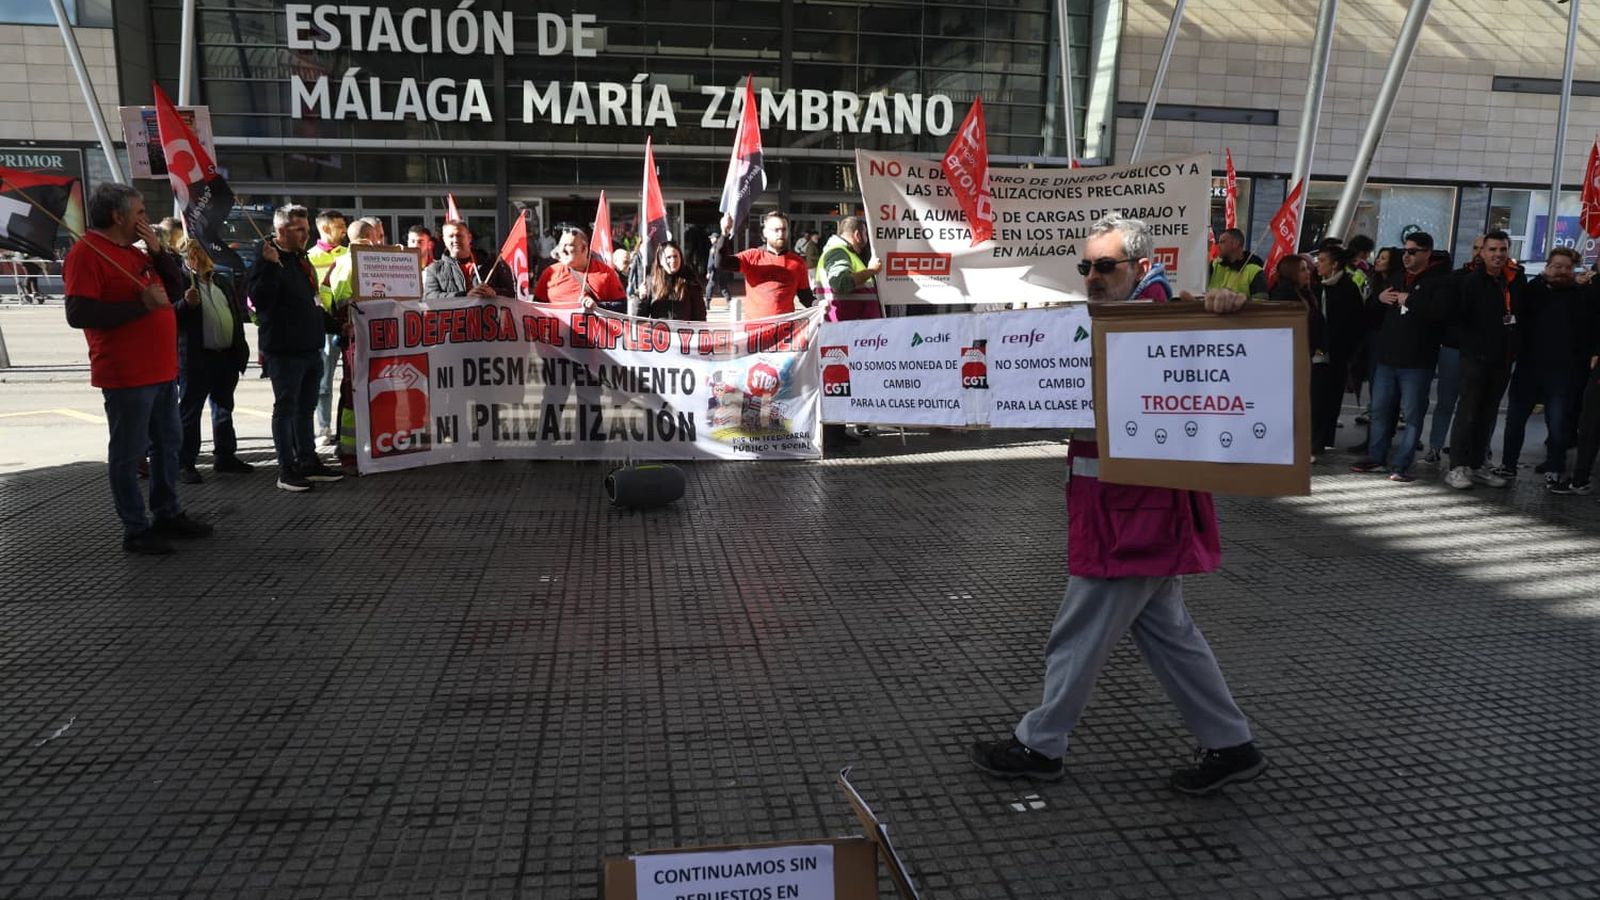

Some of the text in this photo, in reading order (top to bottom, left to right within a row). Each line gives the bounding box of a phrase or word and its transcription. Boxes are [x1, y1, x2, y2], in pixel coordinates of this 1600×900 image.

[285, 0, 597, 57] ESTACIÓN DE
[291, 66, 954, 137] MÁLAGA MARÍA ZAMBRANO
[869, 160, 902, 177] NO
[908, 166, 924, 179] AL
[1029, 177, 1049, 187] DE
[1053, 174, 1106, 187] DINERO
[1176, 164, 1185, 175] Y
[1189, 163, 1200, 174] A
[906, 185, 932, 197] LAS
[1087, 182, 1166, 198] PRECARIAS
[880, 204, 897, 221] SI
[902, 210, 920, 221] AL
[1003, 211, 1021, 223] DE
[1026, 210, 1085, 223] CARGAS
[1178, 206, 1187, 218] Y
[876, 227, 934, 241] EMPLEO
[1002, 229, 1022, 241] EN
[1026, 228, 1054, 241] LOS
[993, 243, 1077, 257] EN MÁLAGA
[891, 257, 947, 271] CCOO
[368, 304, 811, 355] EN DEFENSA DEL EMPLEO Y DEL TREN
[854, 333, 889, 351] renfe
[1001, 328, 1046, 348] renfe
[1147, 343, 1247, 358] LA EMPRESA
[850, 360, 958, 371] NO SOMOS MONEDA DE
[995, 359, 1012, 370] NO
[1014, 358, 1057, 370] SOMOS
[437, 356, 696, 396] NI DESMANTELAMIENTO
[752, 370, 777, 391] STOP
[963, 375, 986, 387] CGT
[1038, 377, 1086, 389] CAMBIO
[1163, 369, 1231, 383] PUBLICA
[824, 382, 850, 395] CGT
[883, 378, 922, 390] CAMBIO
[850, 398, 875, 409] PARA
[876, 398, 888, 409] LA
[888, 398, 916, 409] CLASE
[996, 400, 1026, 411] PARA
[1028, 400, 1042, 411] LA
[1044, 400, 1078, 411] CLASE
[436, 401, 698, 444] NI PRIVATIZACIÓN
[376, 428, 428, 453] CGT
[781, 441, 812, 450] SOCIAL
[653, 856, 818, 885] CONTINUAMOS SIN
[777, 884, 799, 899] EN
